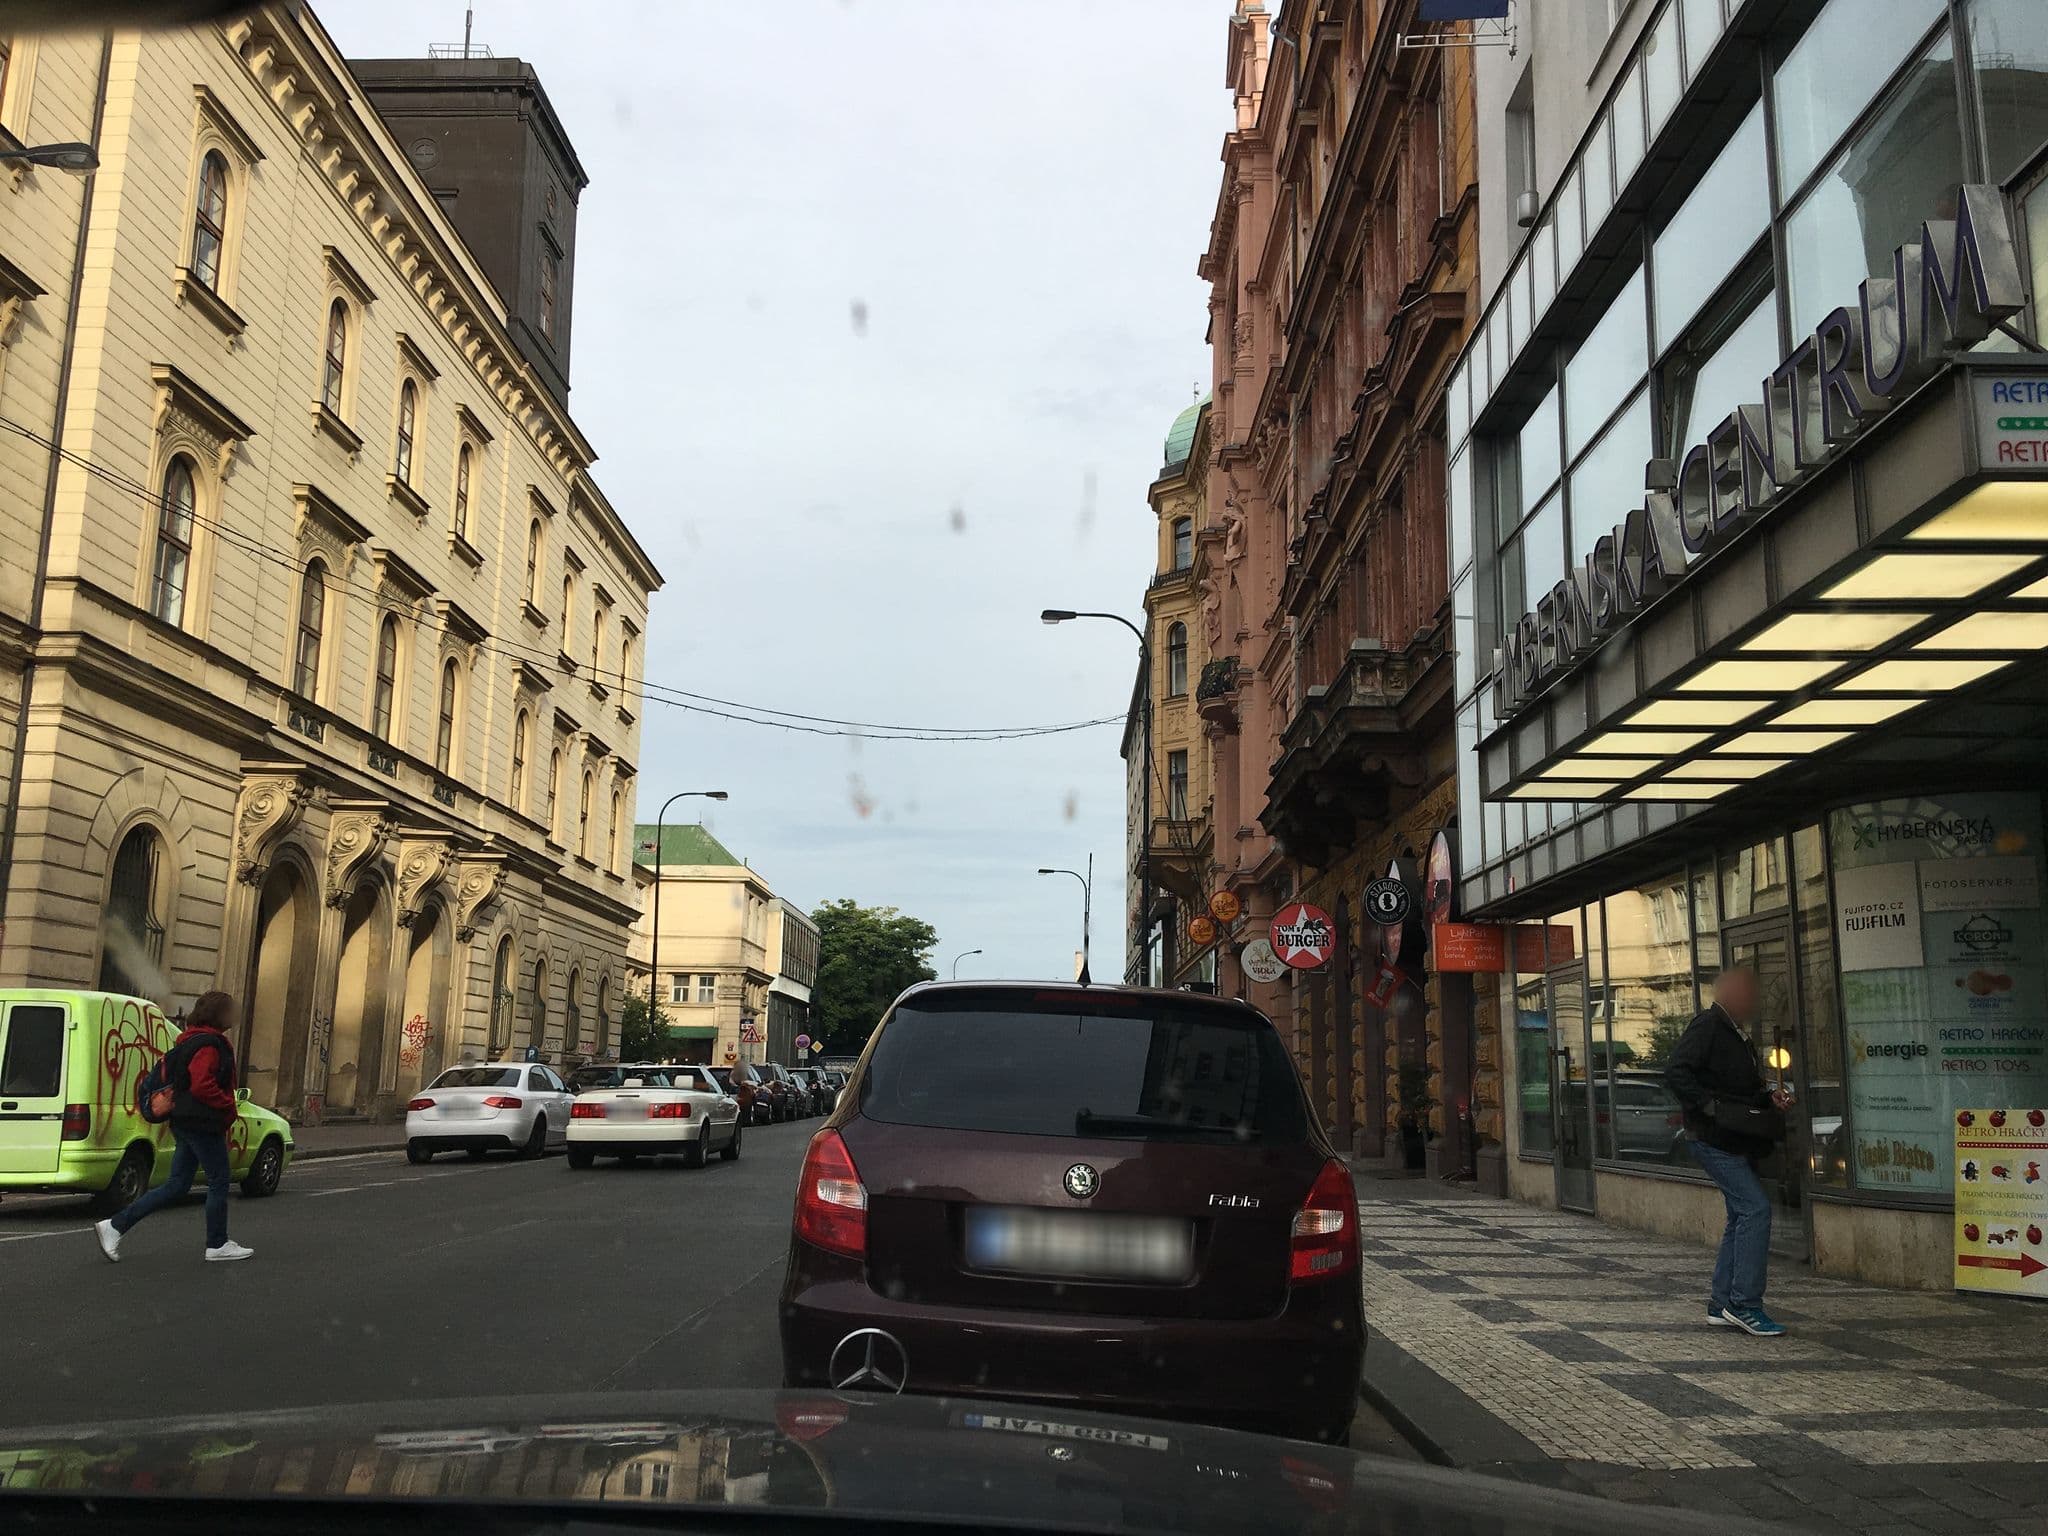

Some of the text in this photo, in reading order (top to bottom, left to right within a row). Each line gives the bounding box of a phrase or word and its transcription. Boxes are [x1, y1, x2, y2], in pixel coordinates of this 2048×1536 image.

[1492, 184, 2026, 720] HYBERNSKÁ CENTRUM
[1877, 814, 1995, 842] HYBERNSKÁ
[1370, 881, 1405, 898] STAROSTA
[1845, 902, 1904, 915] FUJIFOTO.CZ
[1846, 913, 1906, 932] FUJIFILM
[1277, 934, 1330, 947] BURGER
[1939, 1026, 2045, 1041] RETRO HRAČKY
[528, 1049, 535, 1057] P
[1866, 1041, 1928, 1060] energie
[1941, 1059, 2031, 1072] RETRO TOYS
[1958, 1125, 2048, 1138] RETRO HRAČKY
[1209, 1194, 1260, 1208] Fabia
